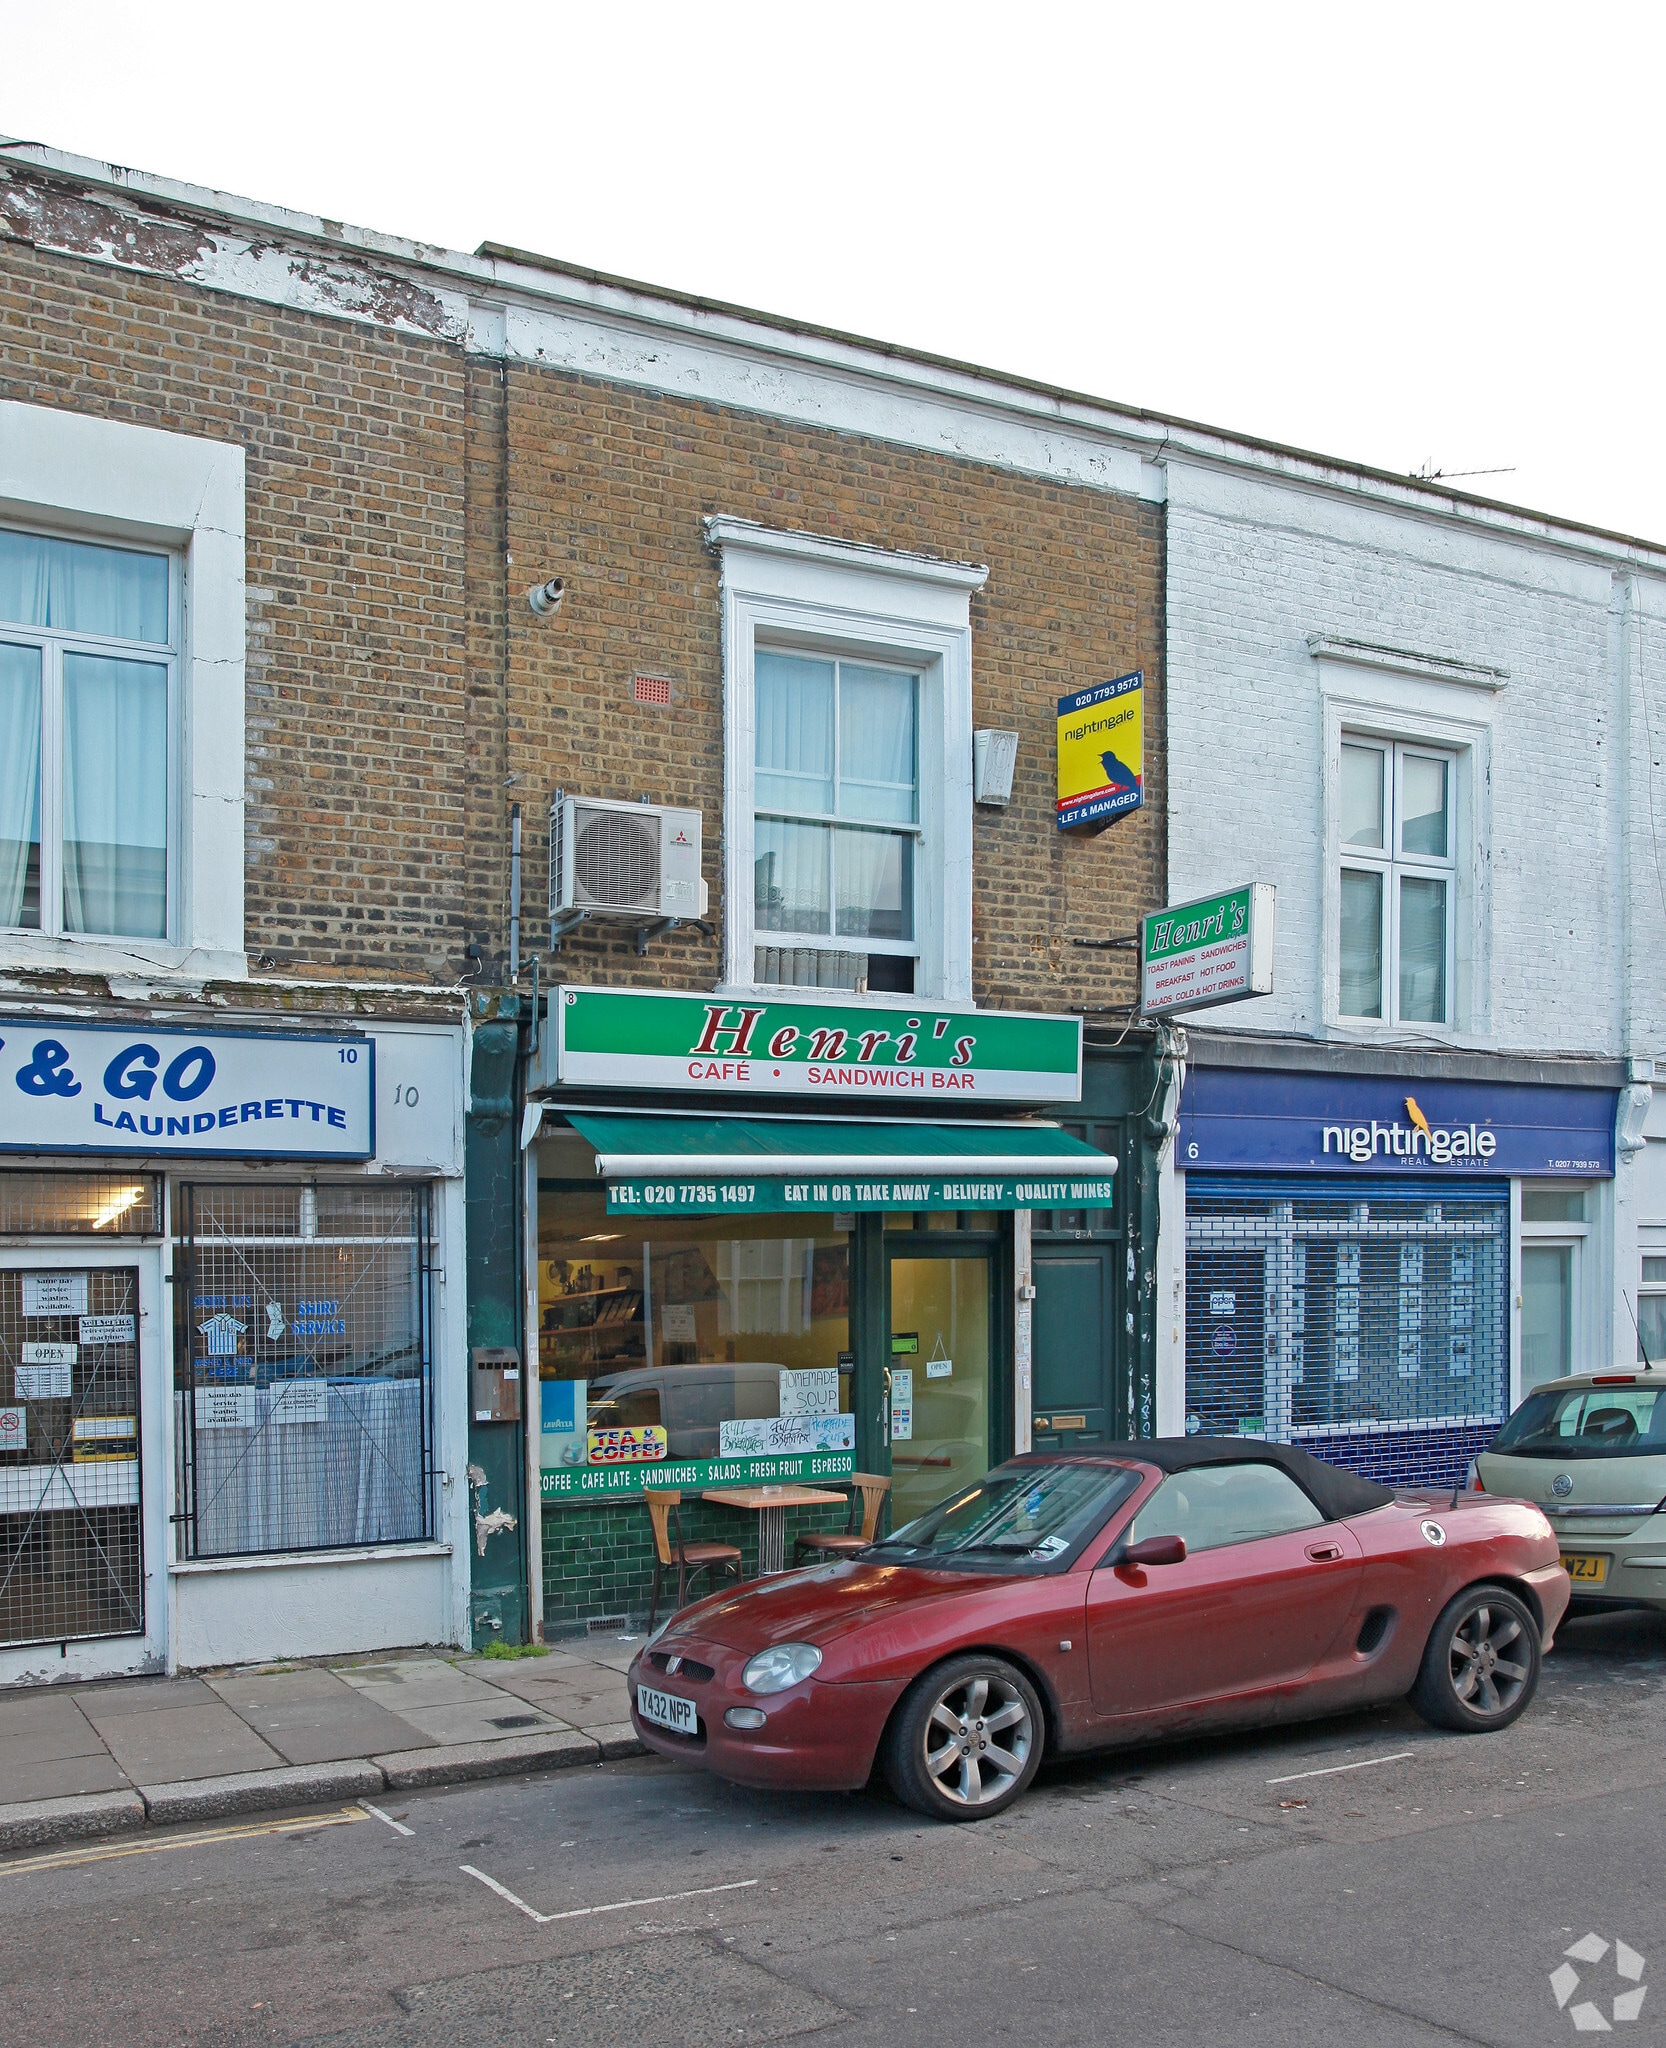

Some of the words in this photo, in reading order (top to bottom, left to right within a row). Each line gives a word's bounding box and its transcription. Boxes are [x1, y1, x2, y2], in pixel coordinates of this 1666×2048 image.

[1075, 693, 1092, 707] 020
[1093, 685, 1116, 701] 7793
[1117, 676, 1139, 693] 9573
[1064, 709, 1135, 741] nightingale
[1061, 810, 1080, 824] LET
[1080, 807, 1088, 818] &
[1089, 792, 1138, 815] MANAGED
[1149, 900, 1246, 954] Henri's
[1146, 961, 1169, 975] TOAST
[1169, 955, 1196, 969] PANINIS
[1200, 940, 1248, 961] SANDWICHES
[1155, 972, 1195, 989] BREAKFAST
[1199, 966, 1215, 978] HOT
[1215, 960, 1237, 974] FOOD
[567, 993, 576, 1005] 8
[1146, 994, 1173, 1009] SALADS
[1175, 989, 1195, 1001] COLD
[1195, 986, 1201, 996] &
[1202, 983, 1217, 994] HOT
[1218, 976, 1245, 991] DRINKS
[687, 1003, 977, 1066] Henri's
[338, 1048, 358, 1064] 10
[15, 1039, 83, 1098] &
[102, 1043, 217, 1102] GO
[687, 1060, 750, 1081] CAFÉ
[807, 1067, 925, 1088] SANDWICH
[931, 1072, 976, 1090] BAR
[393, 1083, 420, 1108] 10
[94, 1098, 347, 1136] LAUNDERETTE
[1187, 1142, 1199, 1159] 6
[1322, 1120, 1497, 1163] nightingale
[1400, 1157, 1430, 1167] REAL
[1449, 1158, 1490, 1167] ESTATE
[1547, 1159, 1554, 1168] T.
[1555, 1160, 1571, 1168] 0207
[1571, 1160, 1588, 1169] 7939
[1588, 1161, 1600, 1169] 573
[608, 1185, 641, 1204] TEL:
[644, 1185, 676, 1204] 020
[679, 1185, 717, 1203] 7735
[719, 1185, 756, 1203] 1497
[784, 1184, 810, 1202] EAT
[812, 1184, 829, 1201] IN
[831, 1184, 852, 1201] OR
[854, 1184, 890, 1201] TAKE
[892, 1184, 931, 1201] AWAY
[942, 1183, 1004, 1201] DELIVERY
[1015, 1183, 1068, 1200] QUALITY
[1070, 1182, 1112, 1199] WINES
[297, 1300, 340, 1317] SHIRT
[1212, 1295, 1234, 1306] open
[290, 1319, 346, 1336] SERVICE
[35, 1348, 65, 1359] OPEN
[930, 1362, 948, 1371] OPEN
[780, 1369, 838, 1389] HOMEMADE
[793, 1390, 838, 1410] SOUP
[543, 1418, 574, 1429] LAVAZZA
[593, 1430, 637, 1447] TEA
[581, 1471, 606, 1489] CAFE
[608, 1470, 631, 1487] LATE
[640, 1466, 697, 1486] SANDWICHES
[708, 1464, 741, 1481] SALADS
[750, 1462, 776, 1478] FRESH
[779, 1459, 803, 1476] FRUIT
[1564, 1559, 1599, 1578] WZJ
[641, 1689, 667, 1720] Y432
[669, 1698, 691, 1727] NPP
